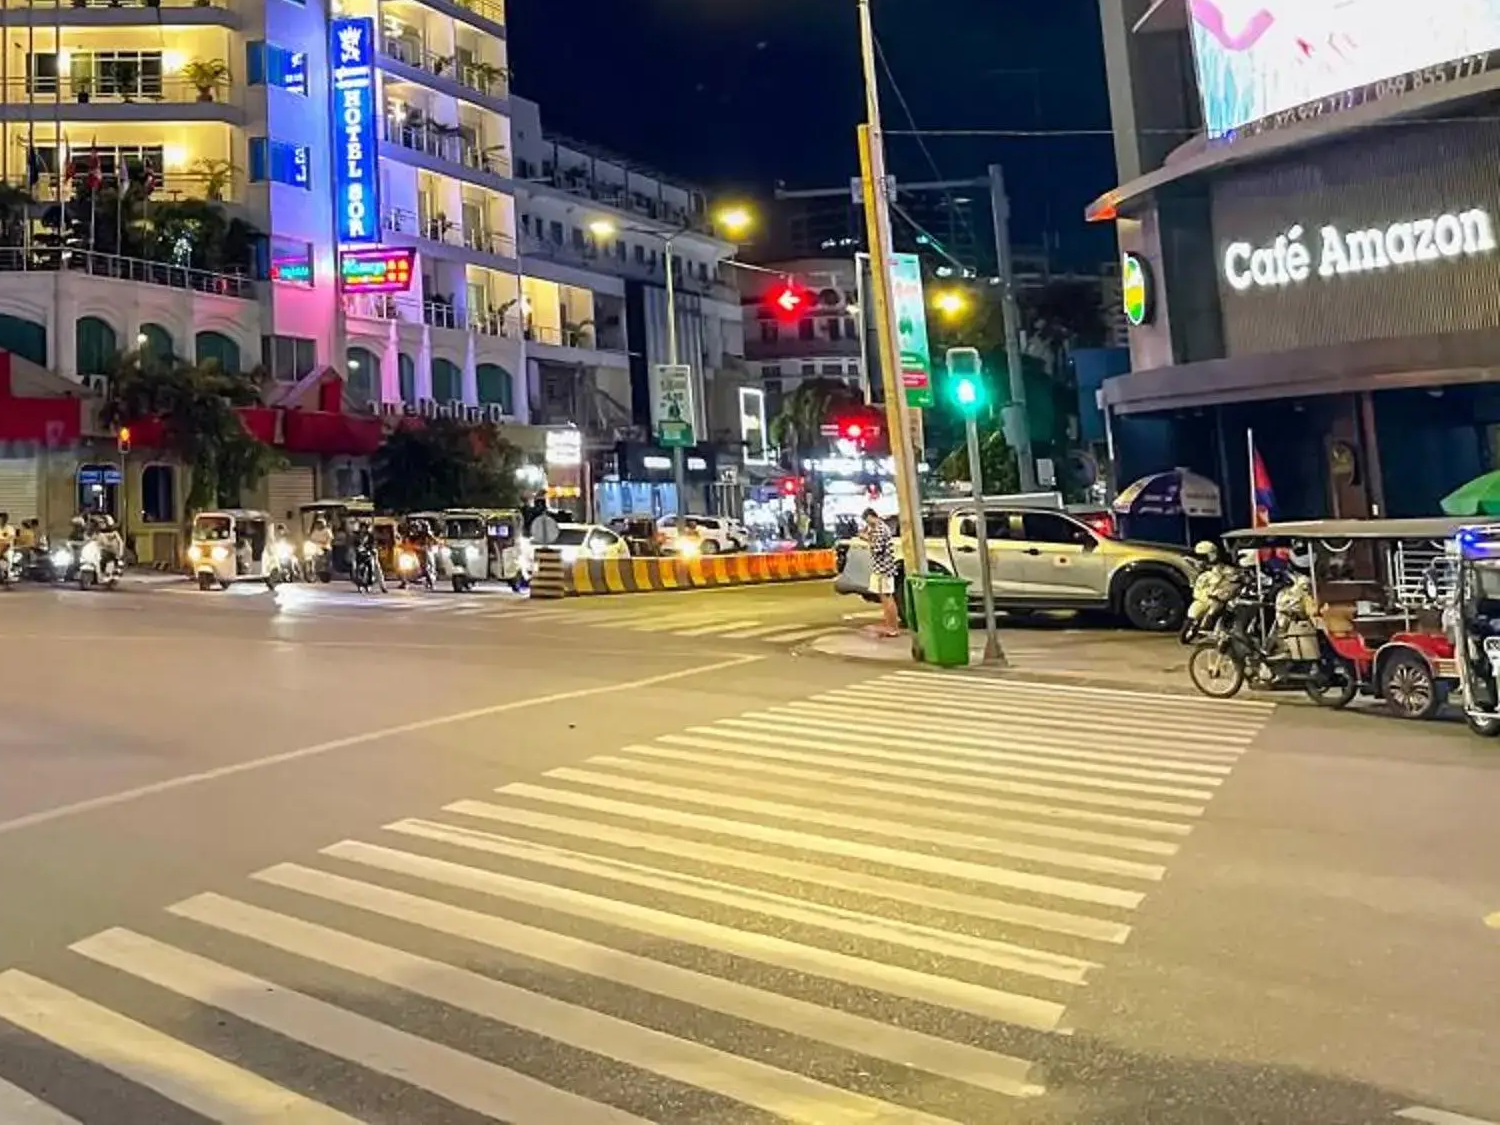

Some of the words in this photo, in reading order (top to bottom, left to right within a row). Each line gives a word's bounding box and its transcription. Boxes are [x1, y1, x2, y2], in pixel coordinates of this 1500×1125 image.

[1451, 51, 1490, 81] 777
[1224, 224, 1311, 290] Café
[1318, 206, 1497, 276] Amazon
